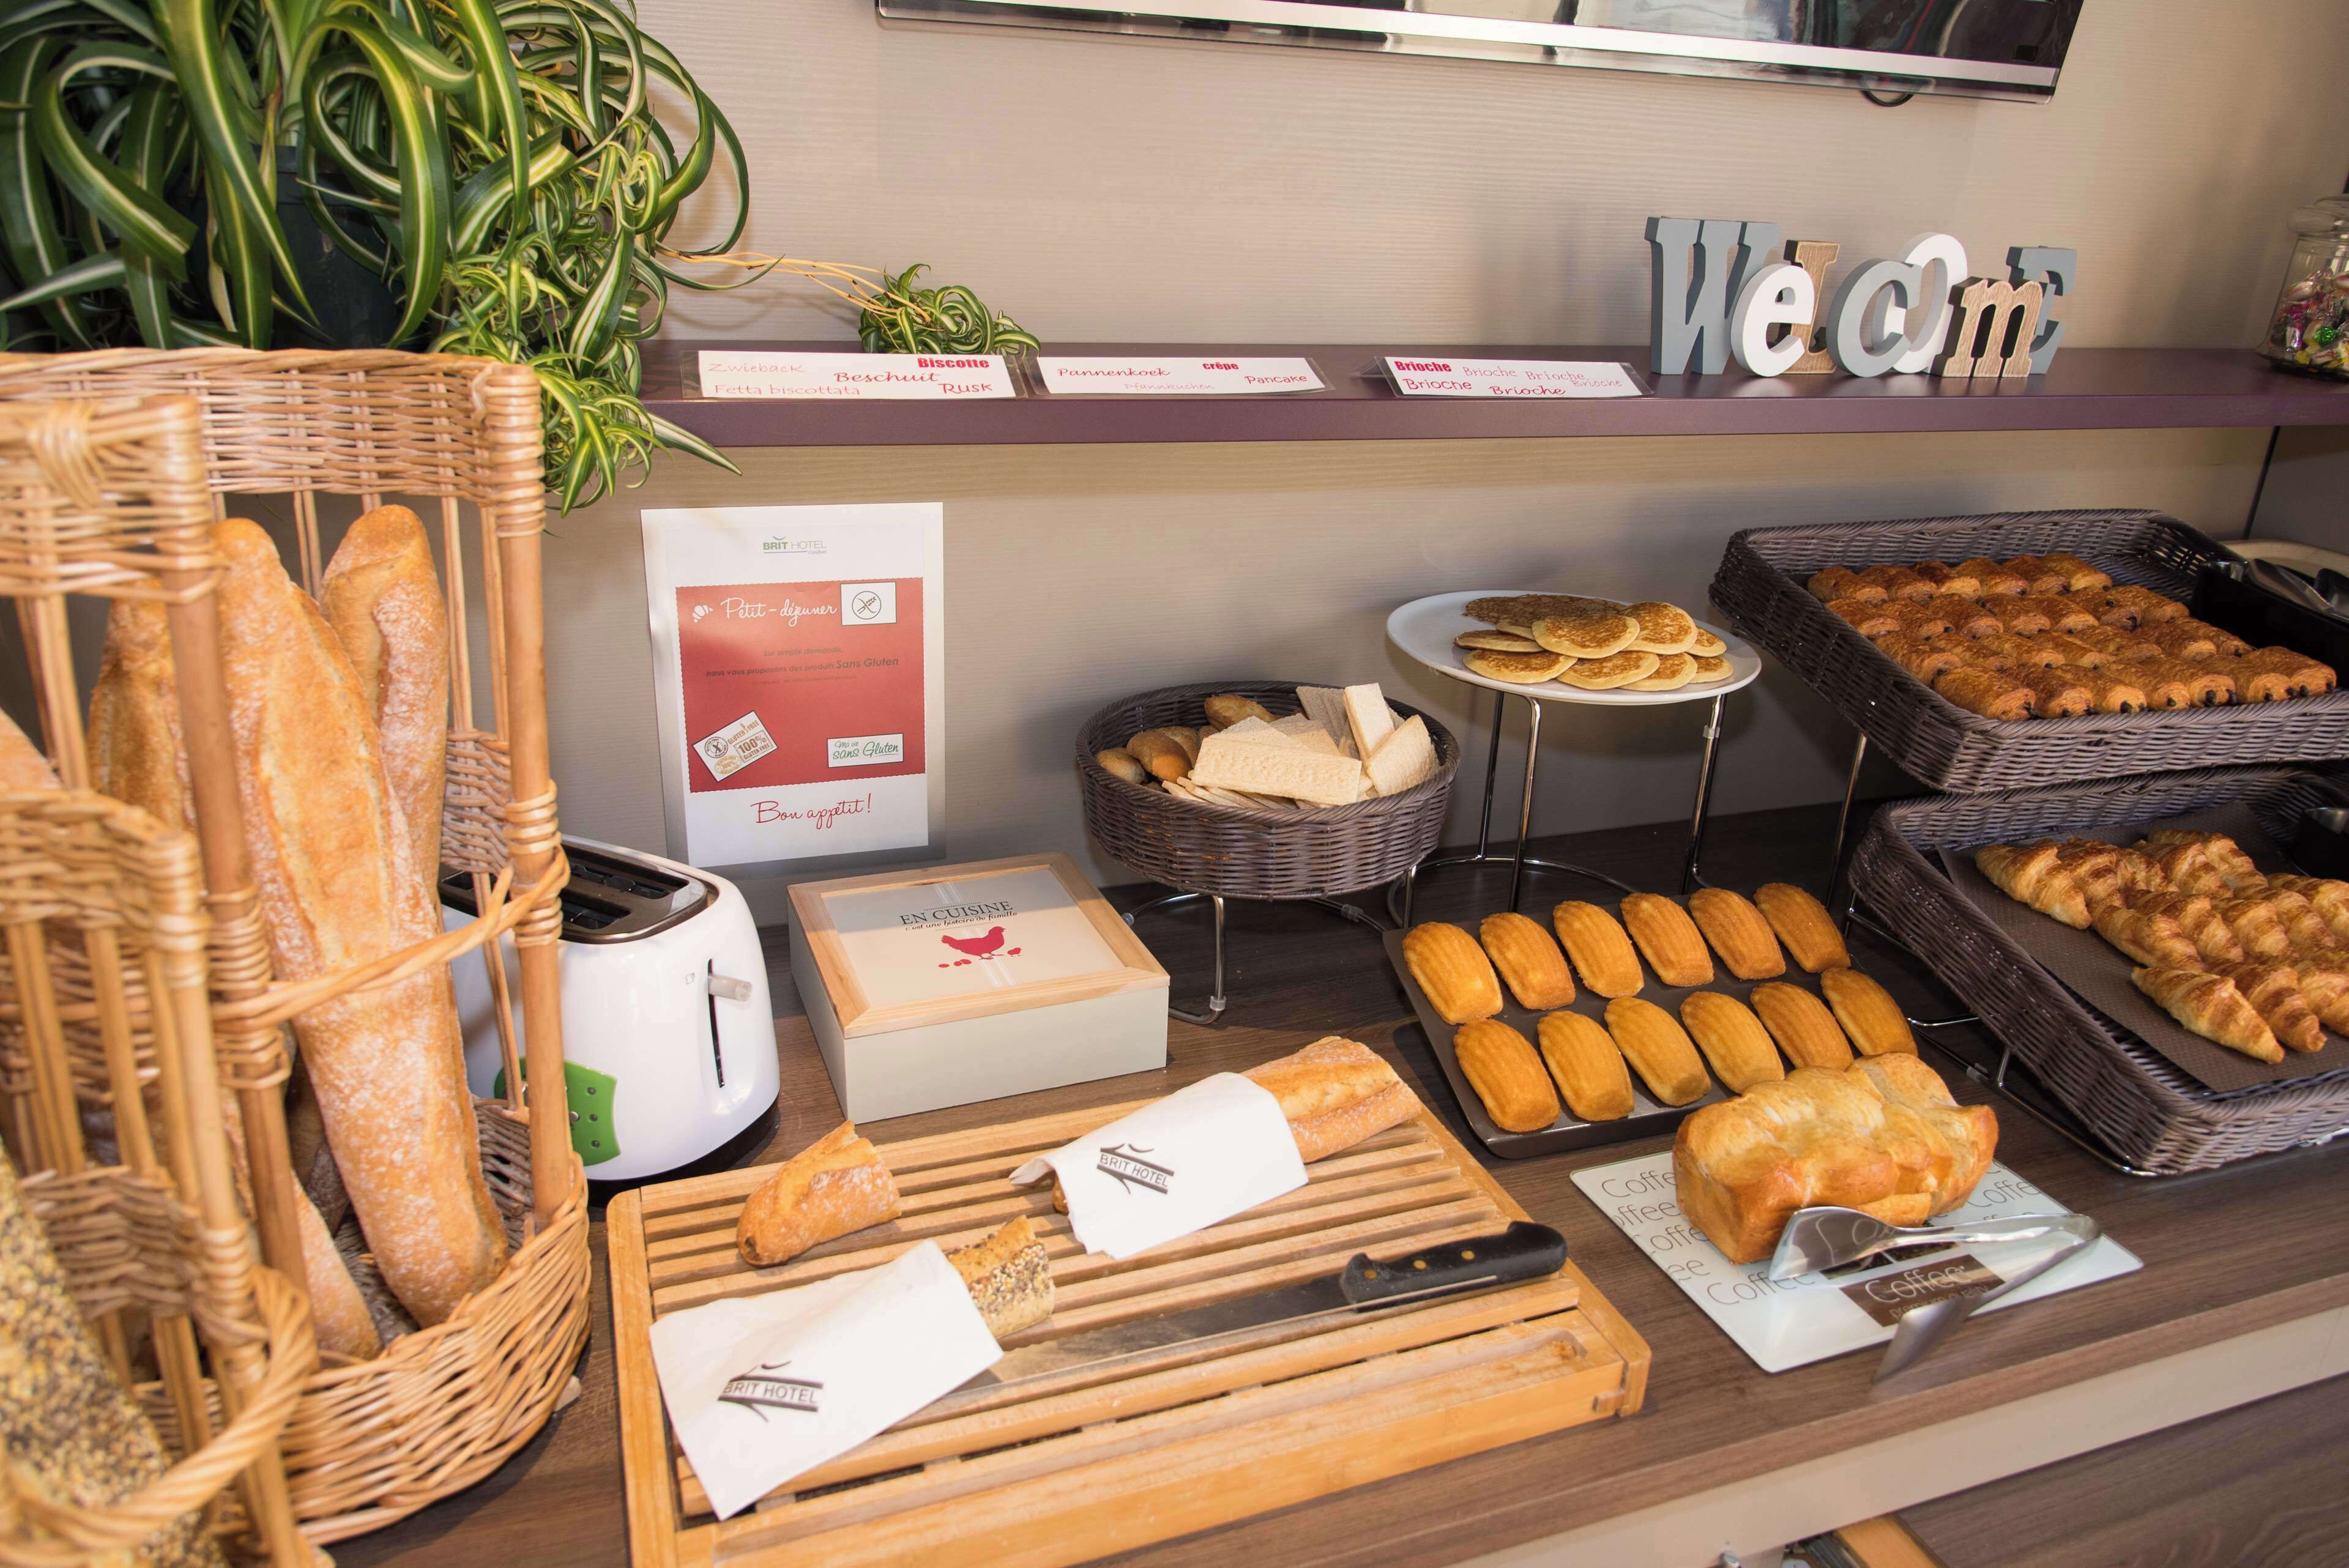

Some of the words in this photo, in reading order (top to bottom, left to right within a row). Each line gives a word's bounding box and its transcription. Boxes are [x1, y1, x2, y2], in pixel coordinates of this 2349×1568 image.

[917, 357, 990, 368] Biscotte
[1394, 361, 1453, 373] Brioche
[833, 371, 941, 383] Beschuit
[1057, 368, 1171, 377] Pannenkoek
[1462, 366, 1517, 377] Brioche
[1524, 371, 1585, 381] Brioche
[1243, 374, 1308, 385] Pancake
[1402, 379, 1472, 391] Brioche
[714, 385, 762, 395] Fetta
[769, 384, 860, 396] biscottata
[938, 383, 993, 394] Rusk
[1489, 385, 1566, 396] Brioche
[763, 541, 788, 550] BRIT
[791, 540, 827, 549] HOTEL
[780, 598, 837, 627] déjeuner
[746, 666, 787, 677] proposons
[805, 663, 835, 672] produits
[835, 660, 862, 669] Sans
[863, 657, 899, 667] Gluten
[727, 729, 746, 745] GLUTEN
[737, 734, 767, 754] 100%
[743, 746, 761, 760] GLUTEN
[759, 742, 770, 752] FREE
[863, 740, 898, 757] Gluten
[750, 801, 803, 823] Bon
[899, 912, 928, 925] EN
[933, 901, 1013, 920] CUISINE
[1100, 1153, 1131, 1172] BRIT
[1131, 1164, 1168, 1187] HOTEL
[1601, 1170, 1677, 1197] Coffe
[1866, 1266, 1972, 1304] Coffee
[723, 1381, 761, 1394] BRIT
[763, 1383, 817, 1403] HOTEL
